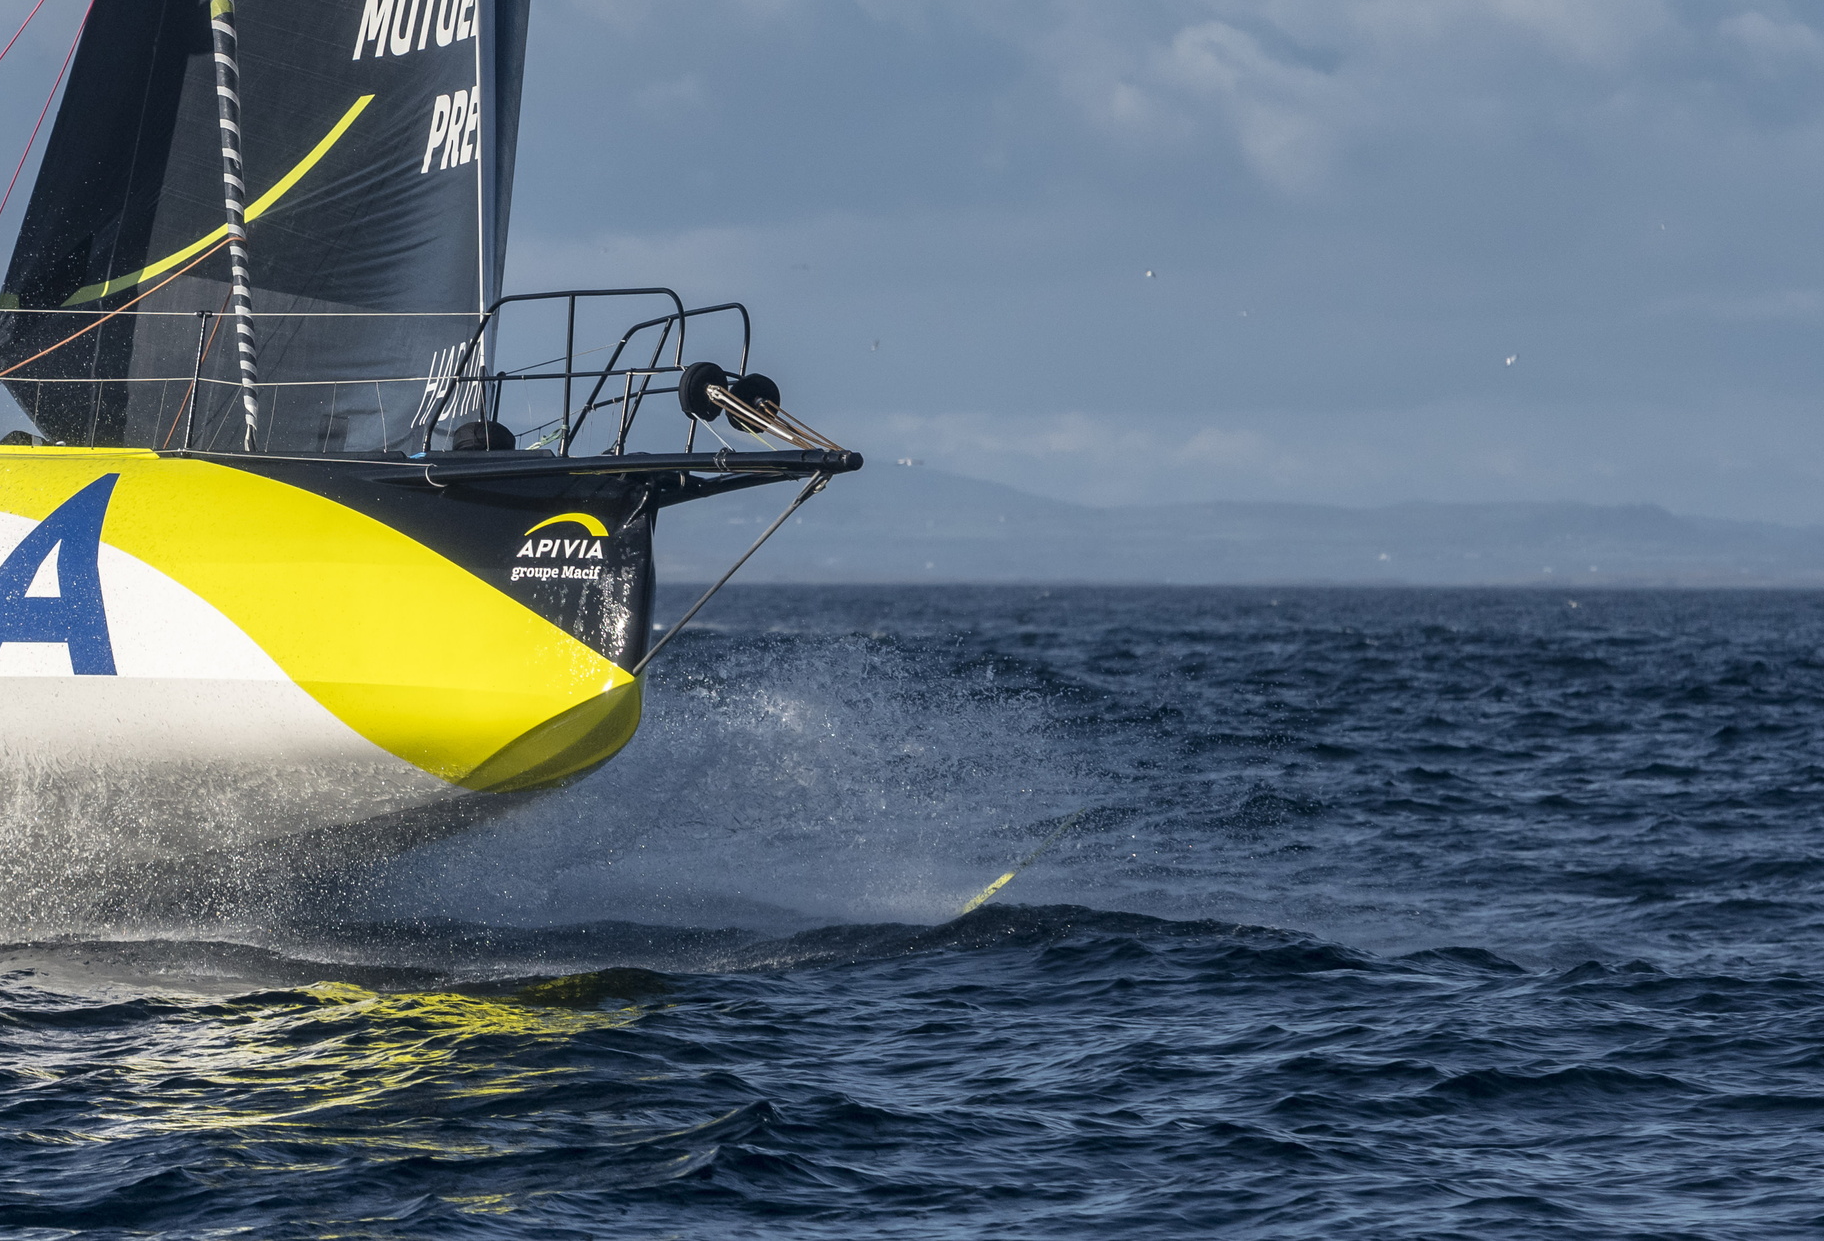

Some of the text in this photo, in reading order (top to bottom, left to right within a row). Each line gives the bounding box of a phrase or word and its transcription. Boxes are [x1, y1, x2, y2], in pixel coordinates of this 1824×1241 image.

[420, 85, 481, 174] PRE
[516, 539, 604, 559] APIVIA
[510, 565, 601, 581] groupe Macif
